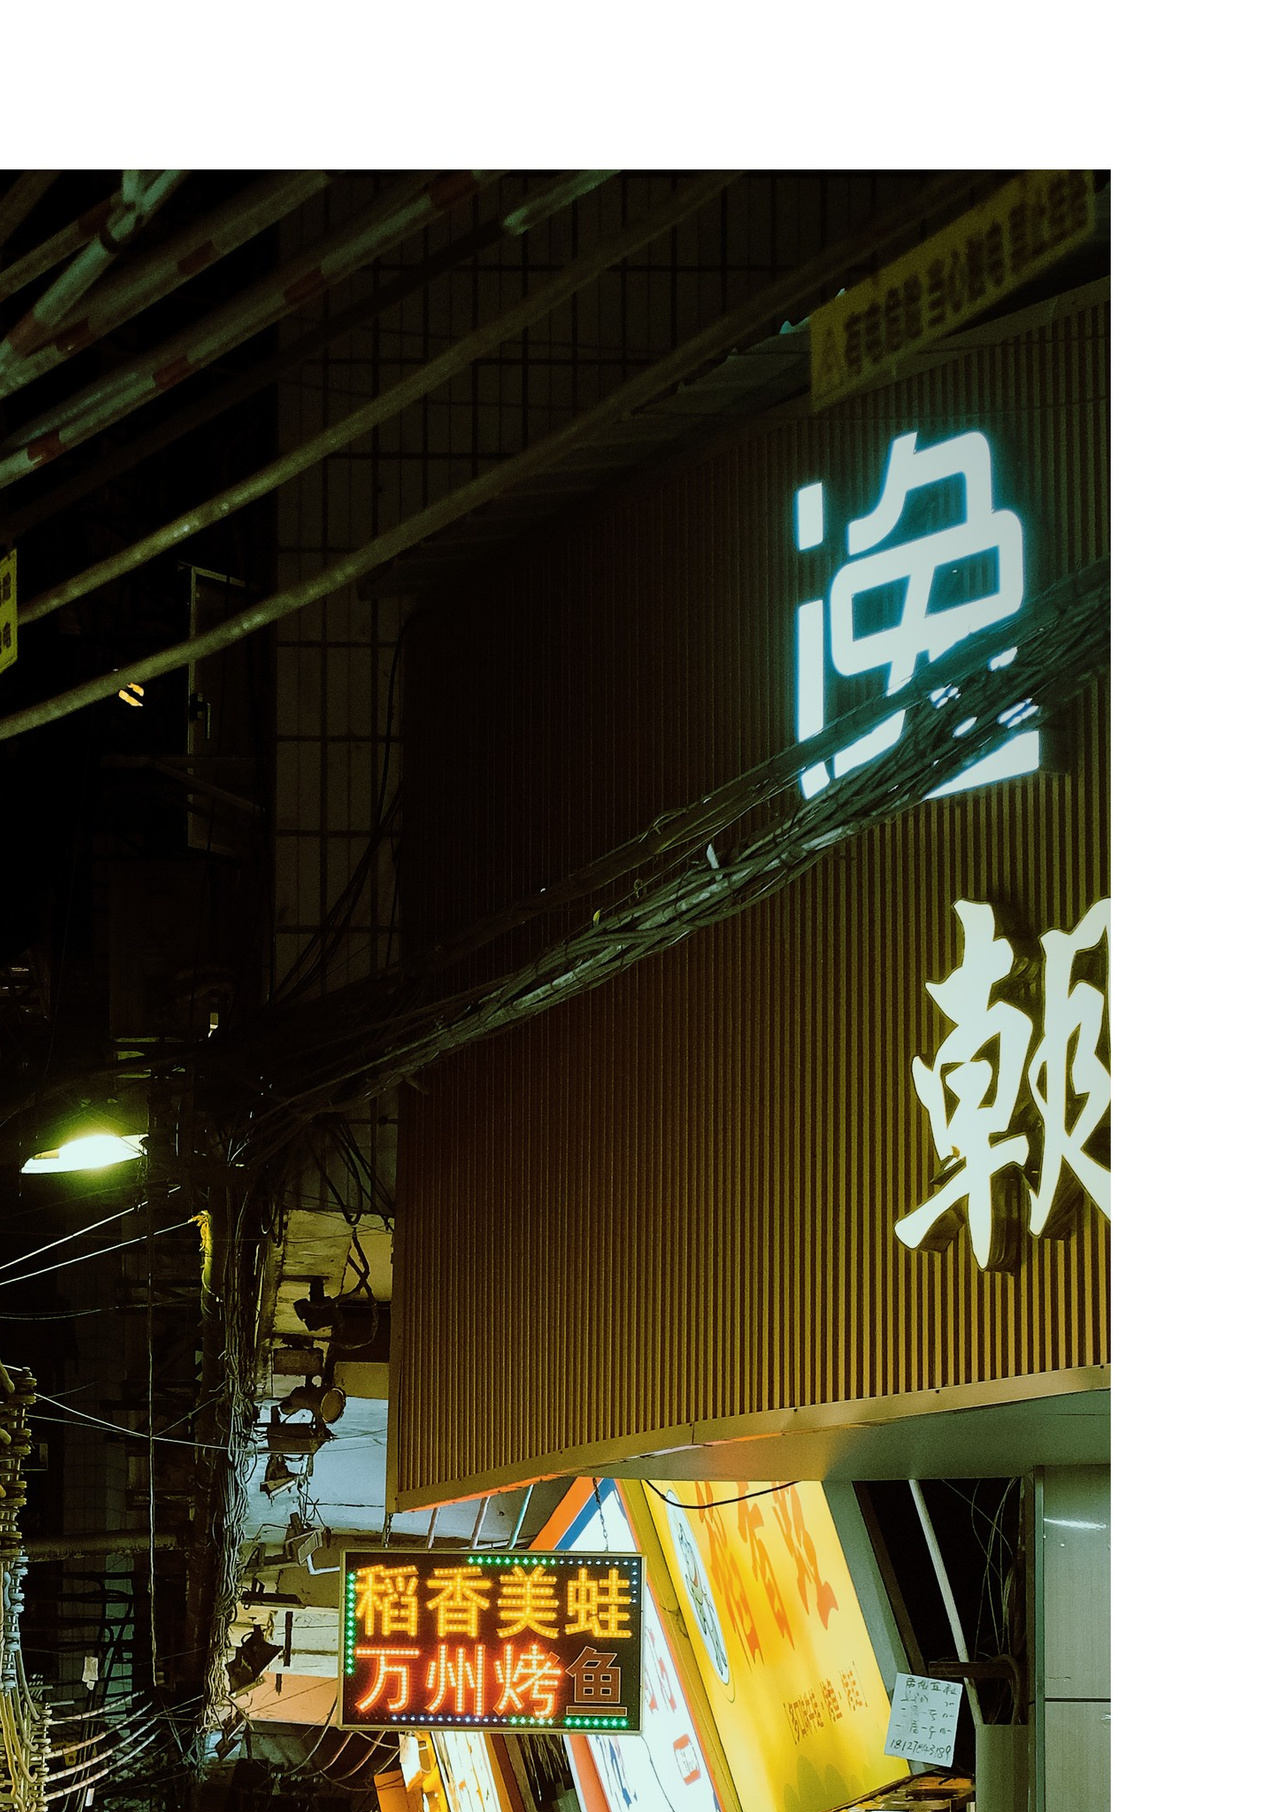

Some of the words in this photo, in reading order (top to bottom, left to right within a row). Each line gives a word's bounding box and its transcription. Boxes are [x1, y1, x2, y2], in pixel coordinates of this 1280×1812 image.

[354, 1564, 633, 1640] 稻香美蛙
[354, 1643, 630, 1718] 万州烤鱼
